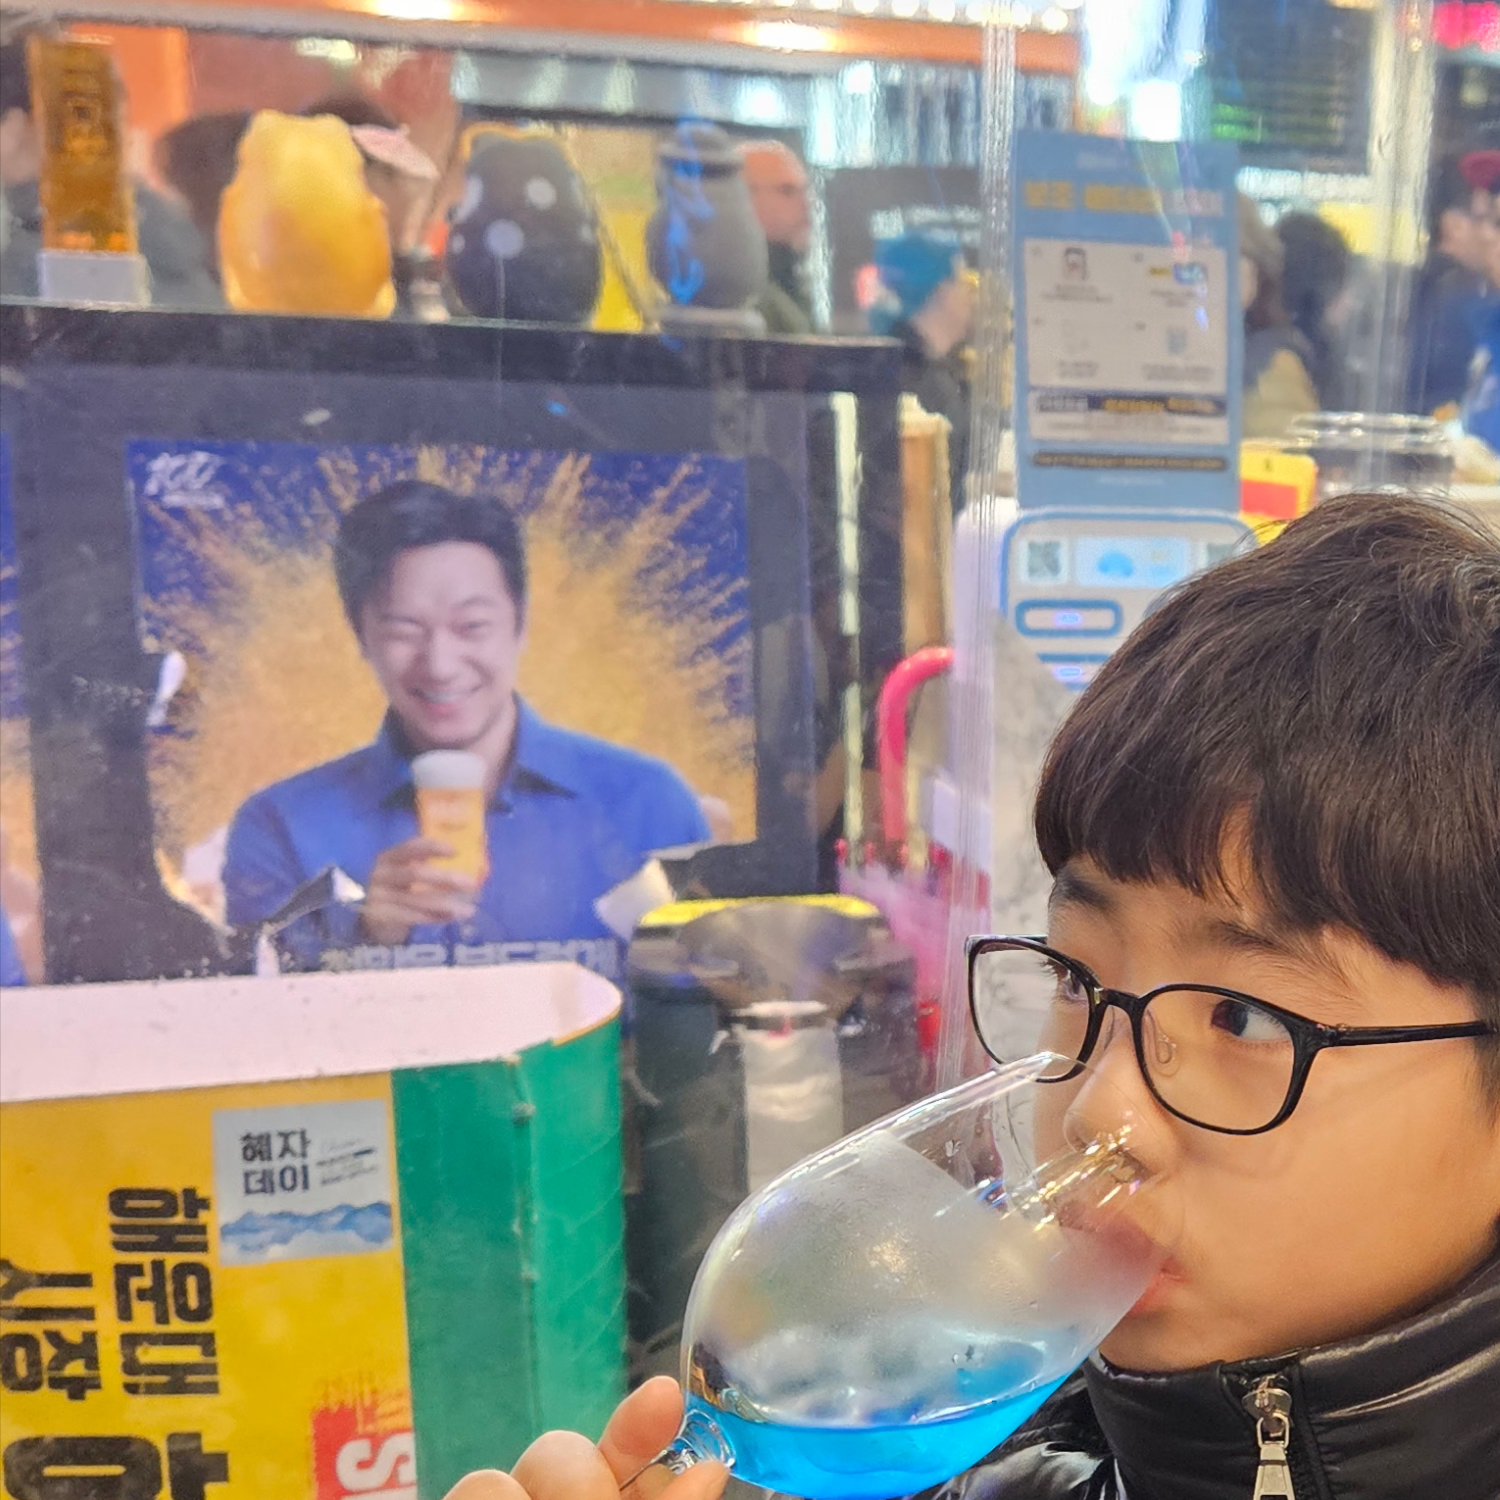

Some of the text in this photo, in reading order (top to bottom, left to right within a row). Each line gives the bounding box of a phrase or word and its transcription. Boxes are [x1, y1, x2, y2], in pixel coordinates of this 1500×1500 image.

[240, 1127, 312, 1163] 혜자
[243, 1163, 310, 1195] 데이
[0, 1258, 102, 1401] 시장
[107, 1186, 220, 1396] 해운대
